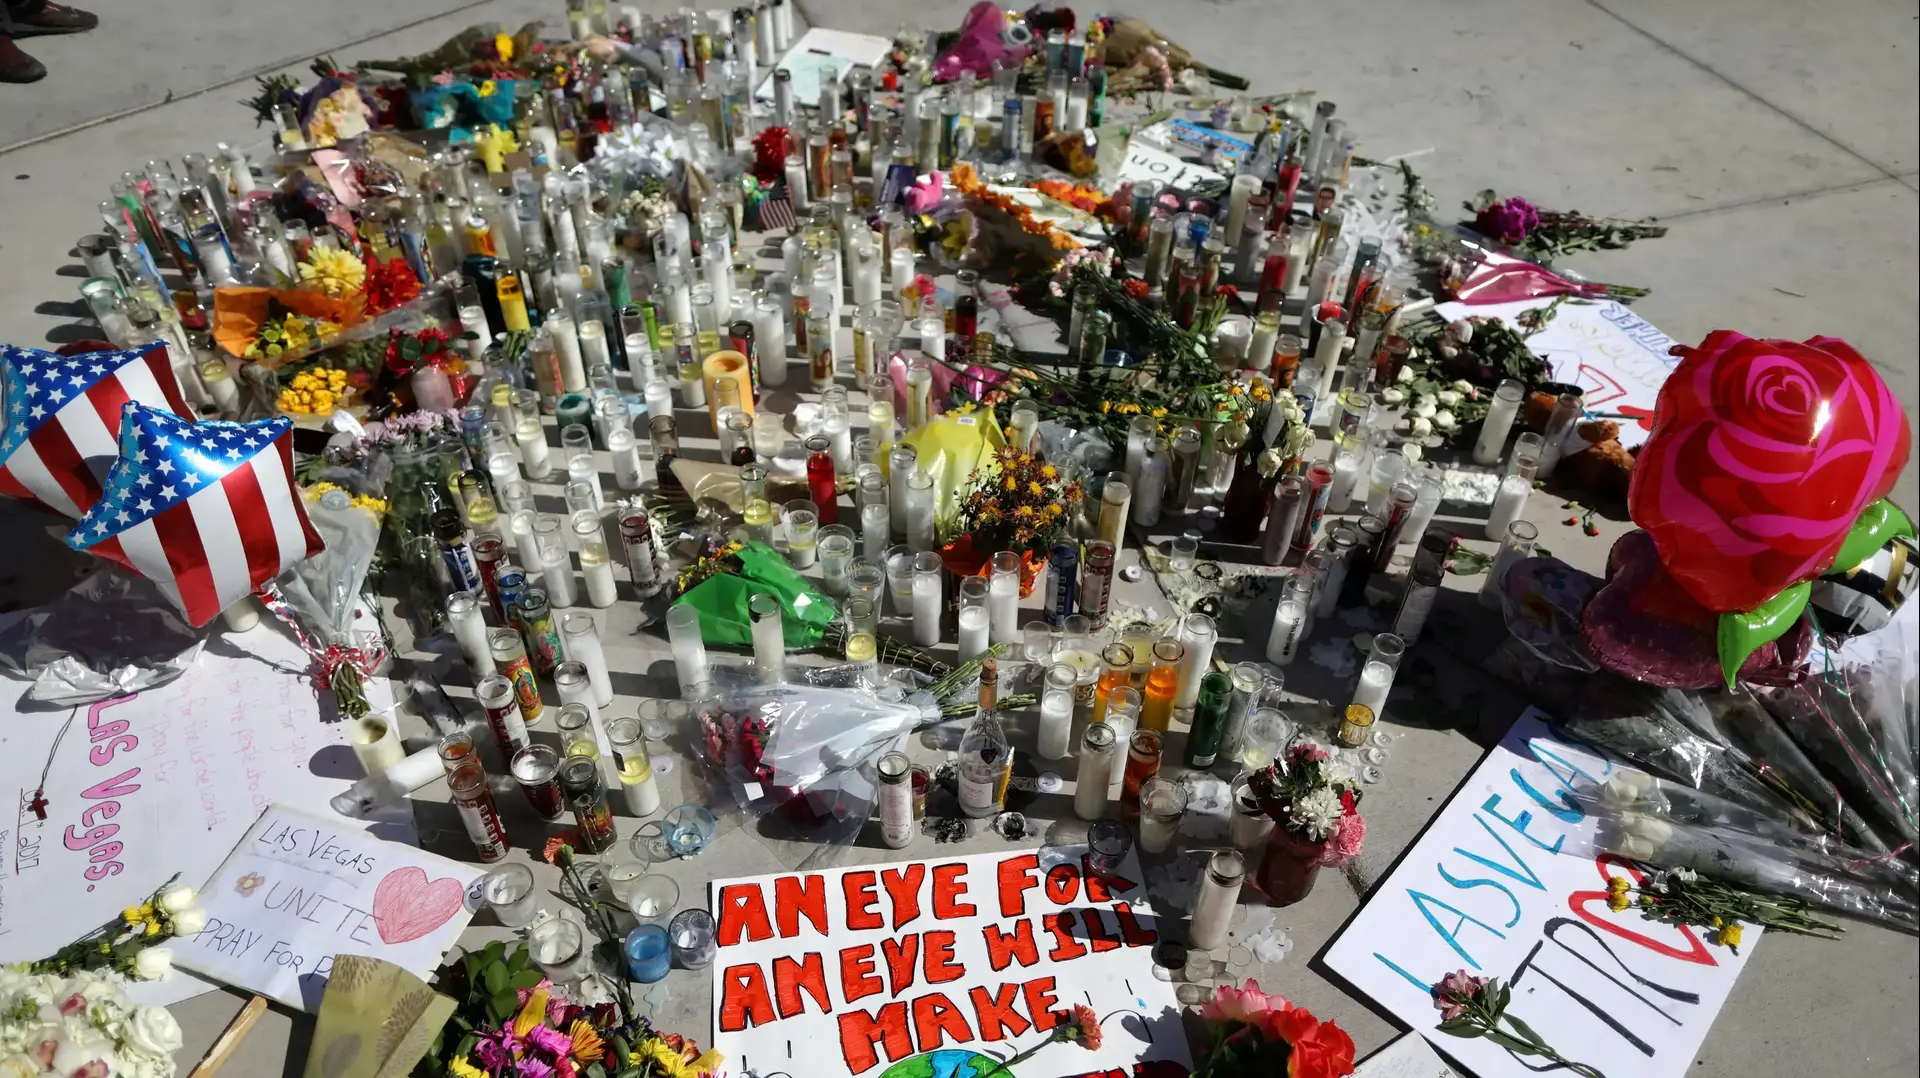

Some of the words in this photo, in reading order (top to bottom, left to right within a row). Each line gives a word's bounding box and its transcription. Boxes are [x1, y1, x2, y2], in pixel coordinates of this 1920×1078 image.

[18, 835, 42, 871] 2017
[258, 819, 305, 852] LAS
[307, 829, 376, 874] VEGAS
[264, 880, 384, 946] UNITE
[717, 874, 829, 948] AN
[841, 862, 978, 932] EYE
[996, 853, 1139, 917] FOR
[193, 918, 263, 958] PRAY
[263, 940, 304, 973] FOR
[719, 951, 832, 1033] AN
[838, 929, 967, 1004] EYE
[982, 902, 1158, 973] WILL
[836, 975, 1072, 1076] MAKE
